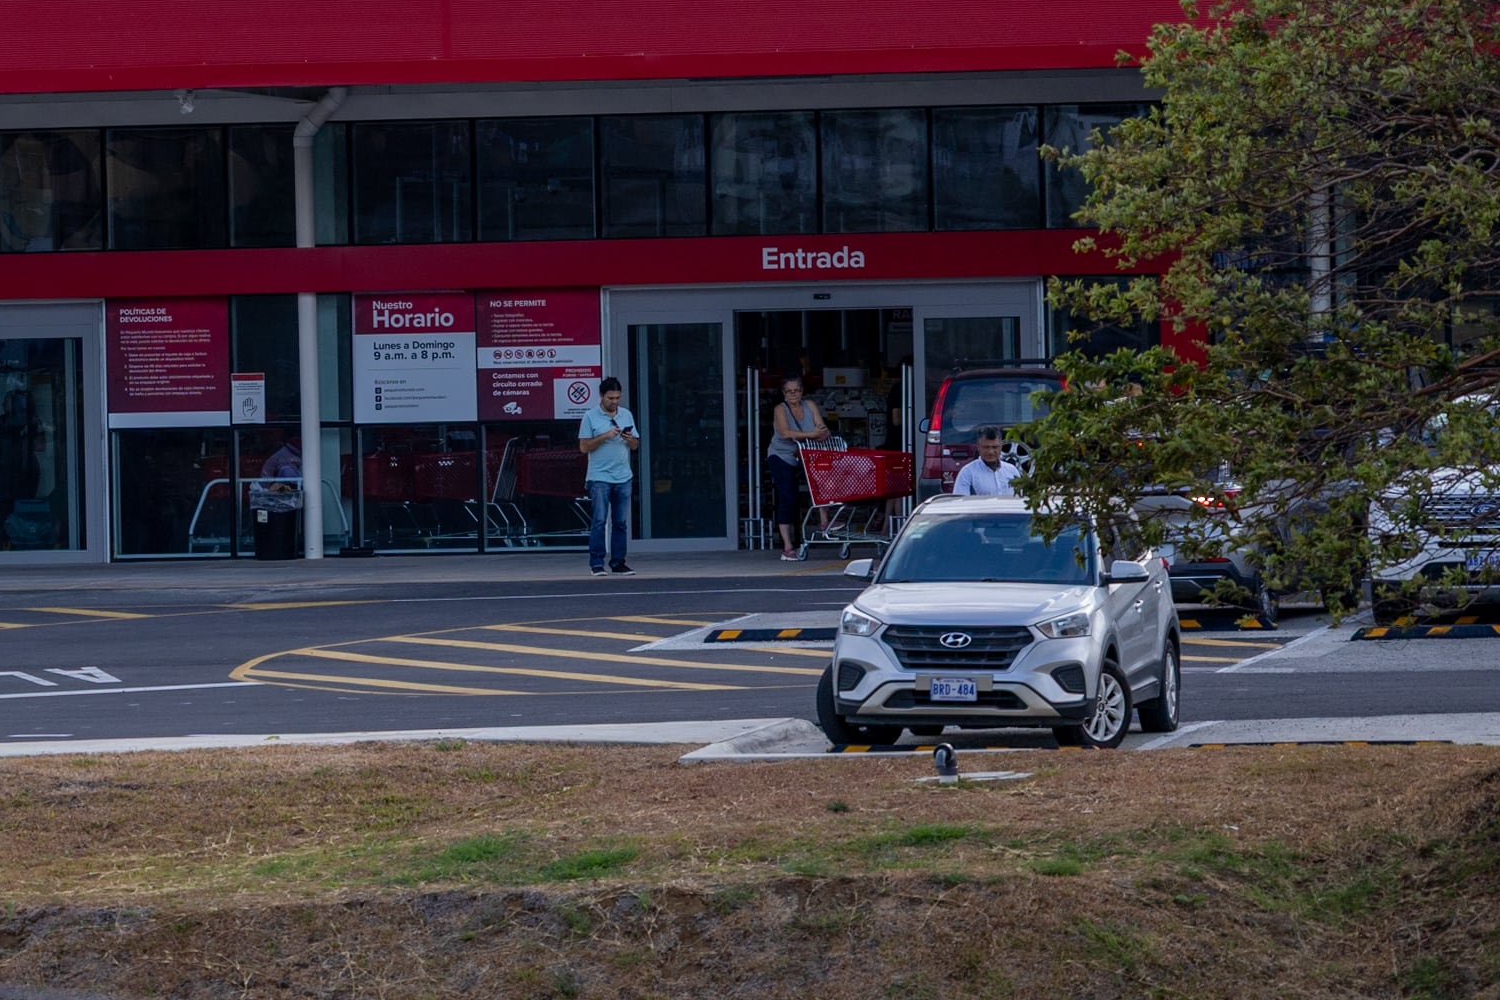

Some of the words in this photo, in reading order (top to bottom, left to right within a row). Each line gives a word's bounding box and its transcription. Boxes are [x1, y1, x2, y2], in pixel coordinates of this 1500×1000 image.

[762, 245, 866, 270] Entrada
[372, 300, 413, 310] Nuestro
[490, 300, 502, 308] NO
[514, 299, 547, 307] PERMITE
[156, 307, 167, 315] DE
[372, 307, 455, 329] Horario
[373, 341, 401, 351] Lunes
[403, 342, 410, 350] a
[412, 340, 455, 351] Domingo
[373, 351, 381, 360] 9
[384, 352, 408, 360] a.m.
[421, 350, 428, 359] 8
[431, 351, 455, 361] p.m.
[933, 683, 975, 696] BRD-484
